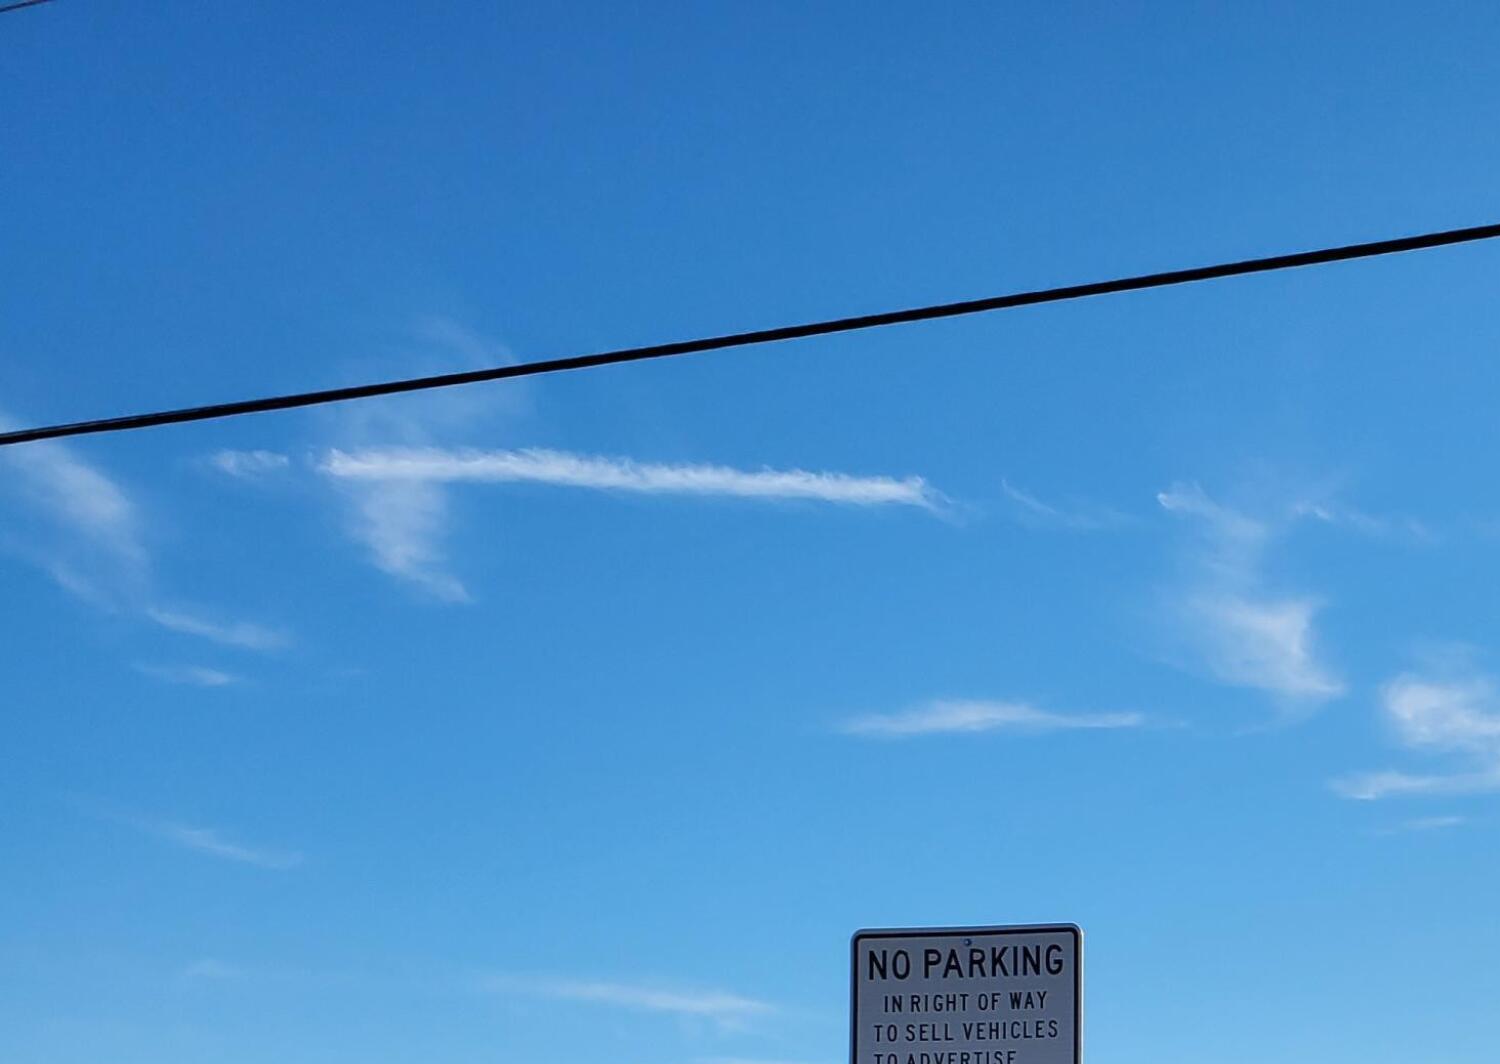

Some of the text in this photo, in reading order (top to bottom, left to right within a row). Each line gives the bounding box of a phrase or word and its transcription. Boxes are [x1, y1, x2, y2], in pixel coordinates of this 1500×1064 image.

[869, 944, 1064, 980] NO PARKING
[884, 991, 1047, 1013] IN RIGHT OF WAY
[874, 1020, 1058, 1042] TO SELL VEHICLES
